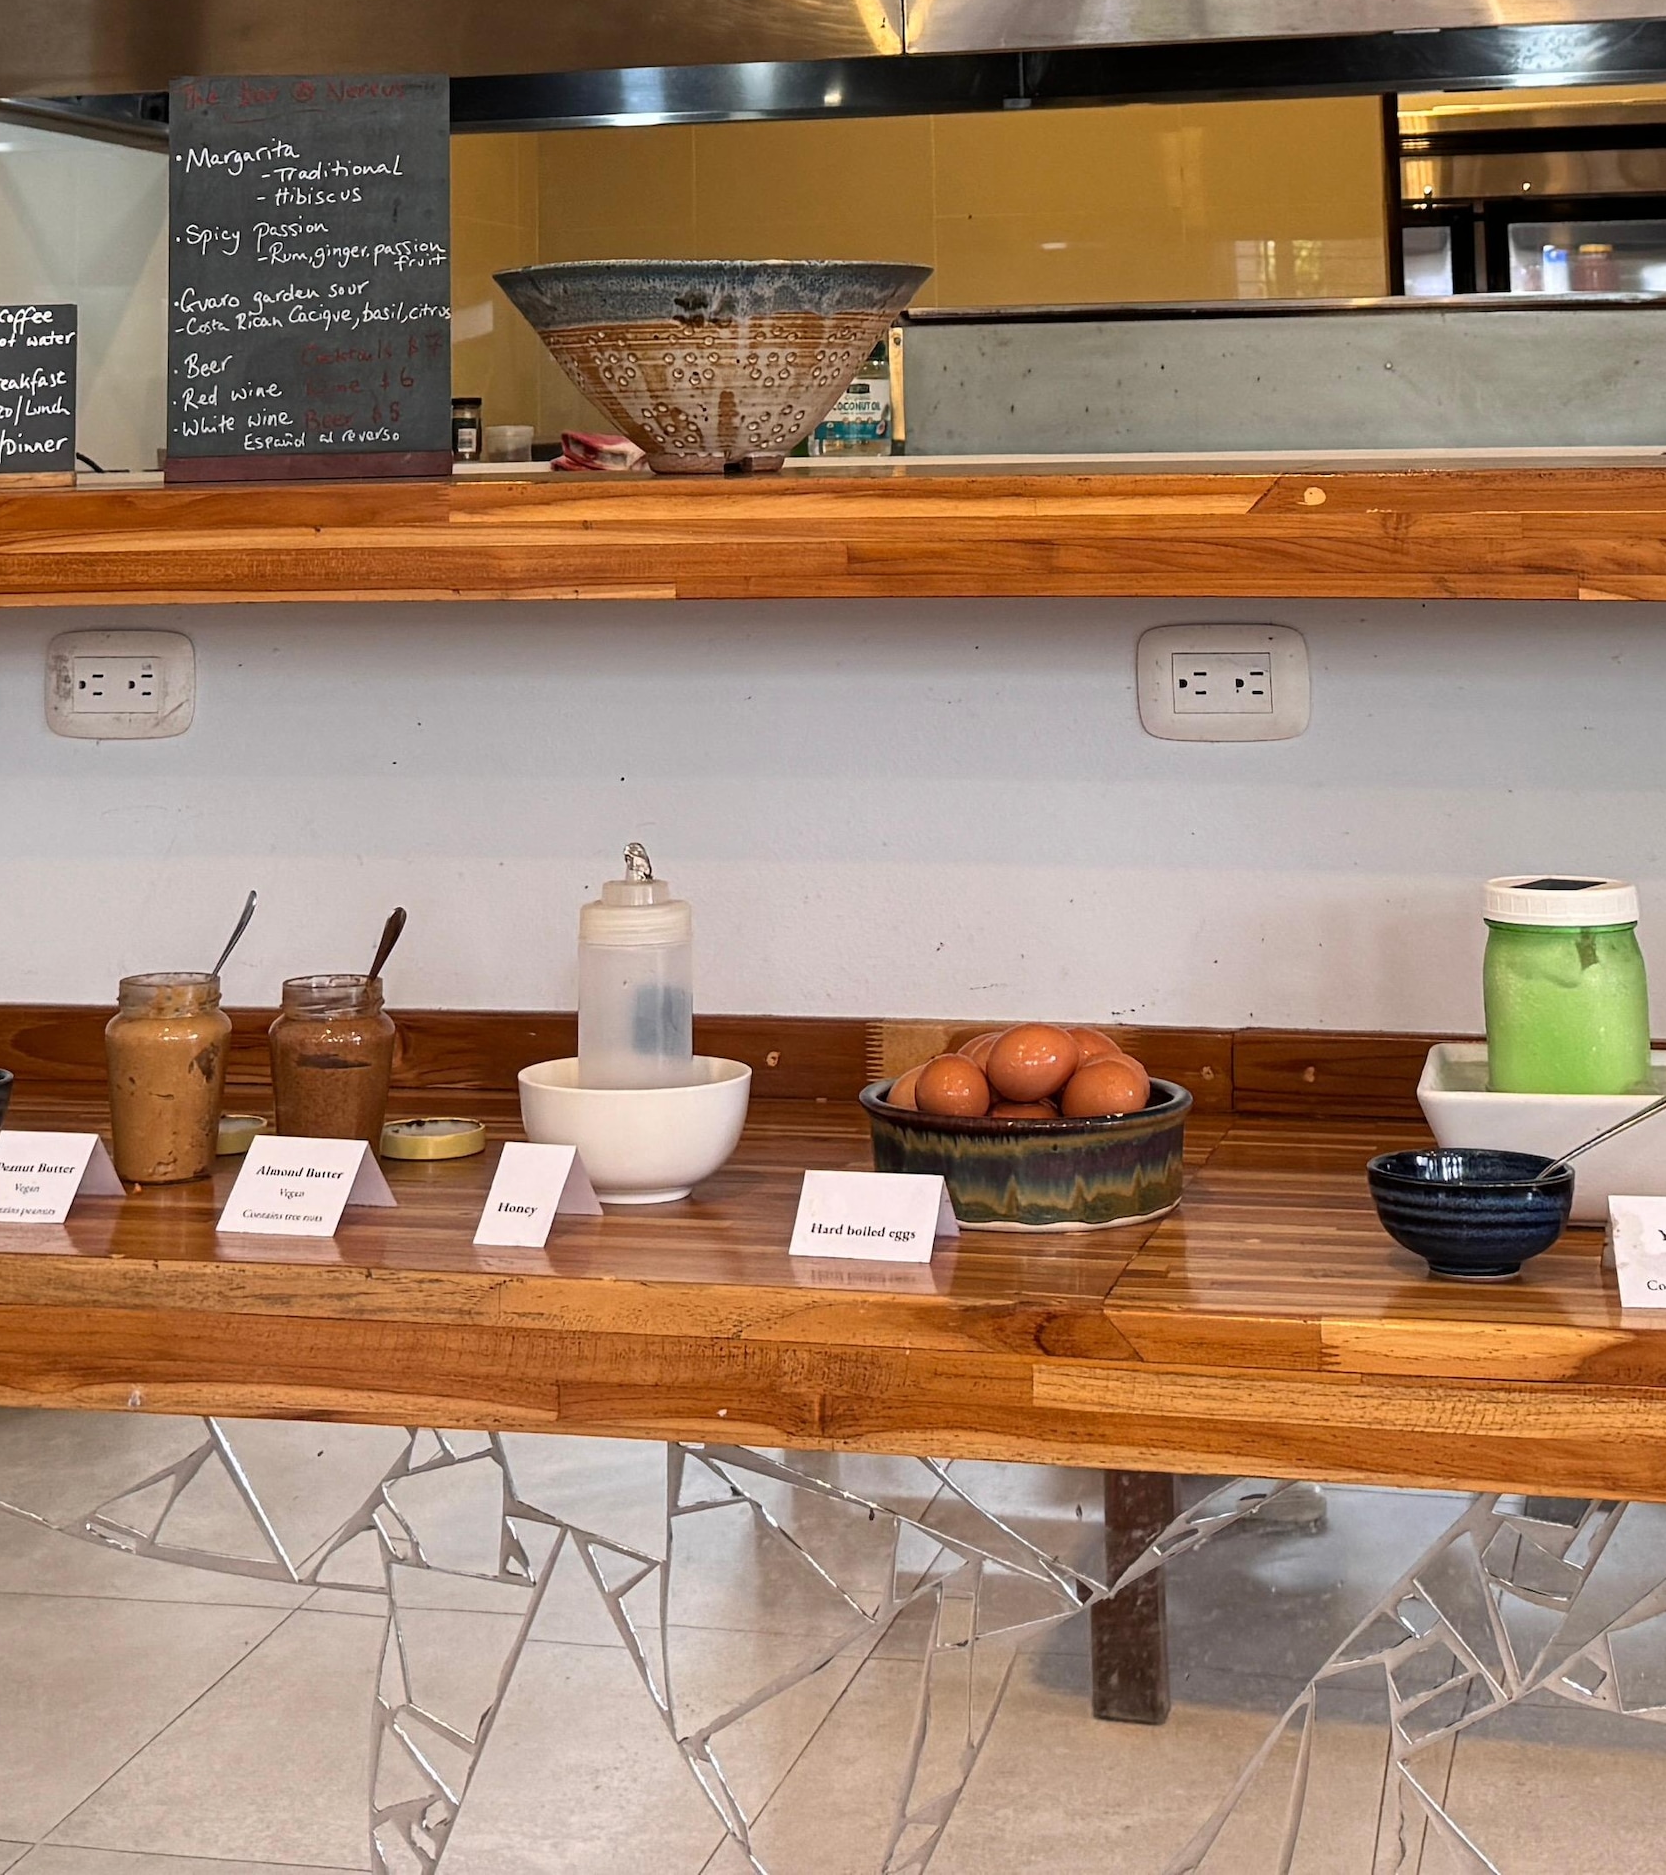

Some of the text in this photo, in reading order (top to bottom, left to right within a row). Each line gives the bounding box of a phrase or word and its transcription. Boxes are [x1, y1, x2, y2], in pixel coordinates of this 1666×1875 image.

[186, 138, 300, 175] Margarita
[275, 187, 361, 206] Hibiscus
[186, 225, 240, 255] Spicy
[181, 281, 369, 317] Guaro garden sour
[235, 312, 283, 330] Rican
[27, 331, 75, 346] water
[184, 353, 232, 378] Beer
[182, 382, 282, 411] Red wine
[833, 402, 870, 411] OCONUT
[183, 408, 293, 436] White wine
[244, 432, 305, 450] Español
[37, 1163, 75, 1174] Butter
[256, 1165, 344, 1179] Almond Butter
[15, 1183, 40, 1195] Vegan
[280, 1188, 304, 1200] Vegan
[498, 1202, 538, 1217] Honey
[811, 1223, 916, 1242] Hard boiled eggs
